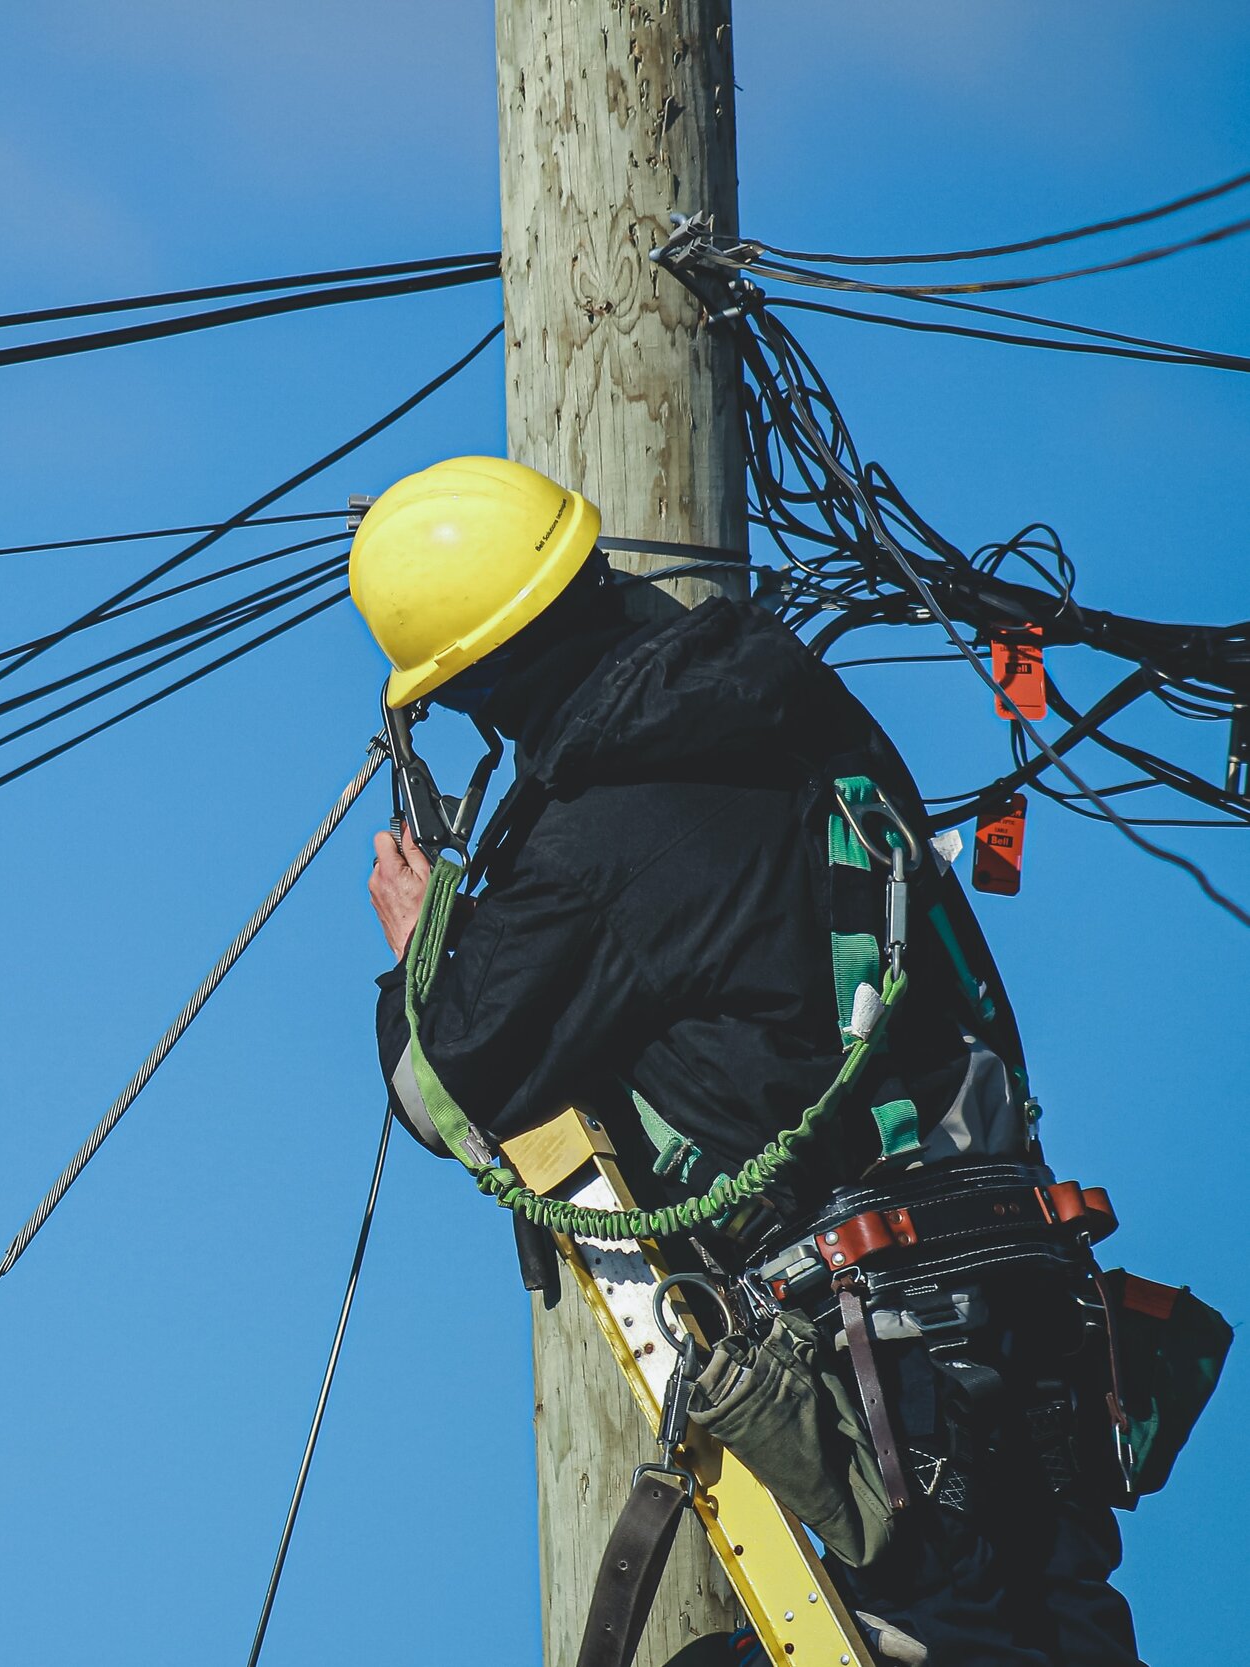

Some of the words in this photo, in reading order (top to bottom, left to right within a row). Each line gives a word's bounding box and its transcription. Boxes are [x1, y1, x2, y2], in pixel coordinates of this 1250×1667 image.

[535, 540, 545, 552] Bell
[543, 519, 558, 541] Solutions
[991, 835, 1009, 846] Bell
